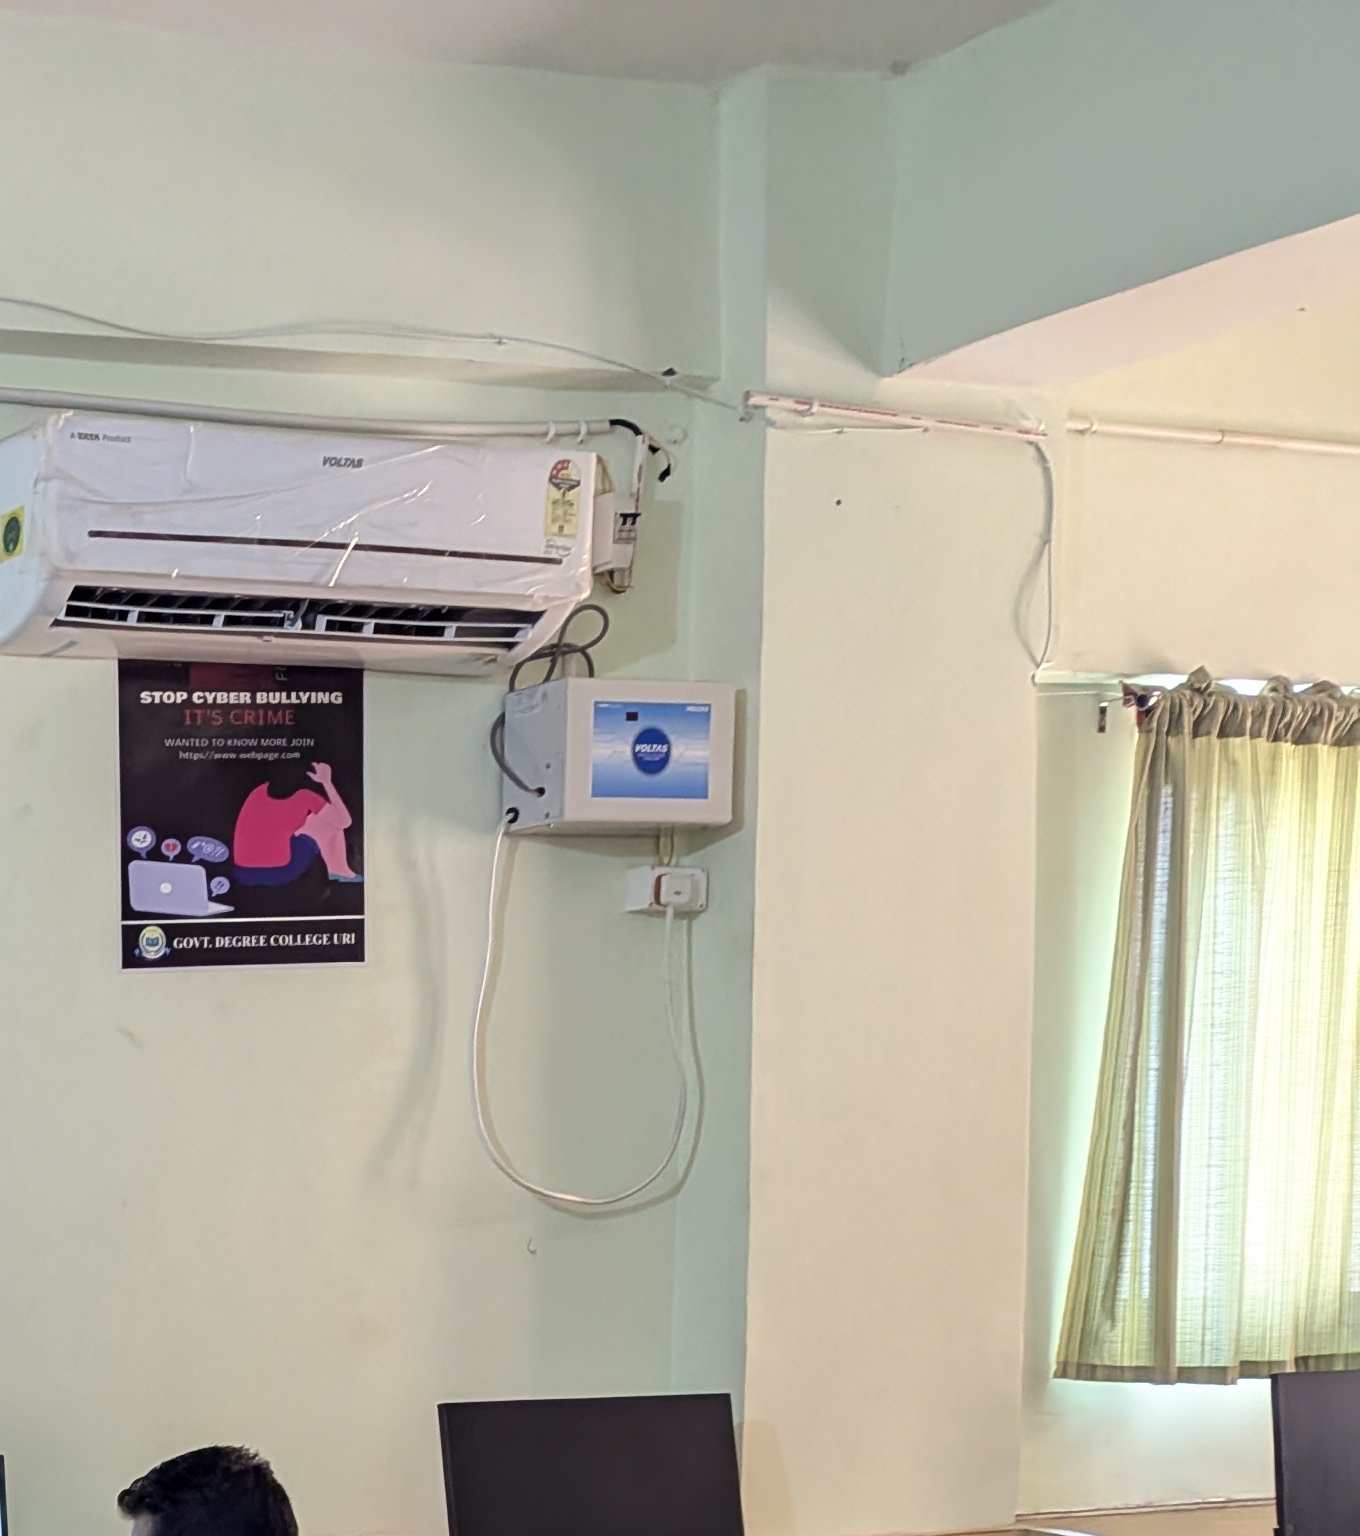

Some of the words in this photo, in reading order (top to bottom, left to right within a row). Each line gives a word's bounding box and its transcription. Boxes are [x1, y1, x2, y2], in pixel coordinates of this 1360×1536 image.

[322, 456, 364, 469] VOLTAS
[139, 690, 188, 705] STOP
[192, 690, 252, 705] CYBER
[255, 690, 343, 705] BULLYING
[182, 708, 224, 726] IT'S
[229, 708, 296, 726] CRIME
[164, 737, 209, 747] WANTED
[211, 738, 225, 747] TO
[226, 738, 259, 747] KNOW
[260, 738, 288, 747] MORE
[290, 738, 315, 747] JOIN
[634, 743, 669, 753] VOLTAS
[173, 936, 213, 949] GOVT.
[215, 935, 268, 948] DEGREE
[270, 933, 331, 947] COLLEGE
[333, 932, 356, 945] URI
